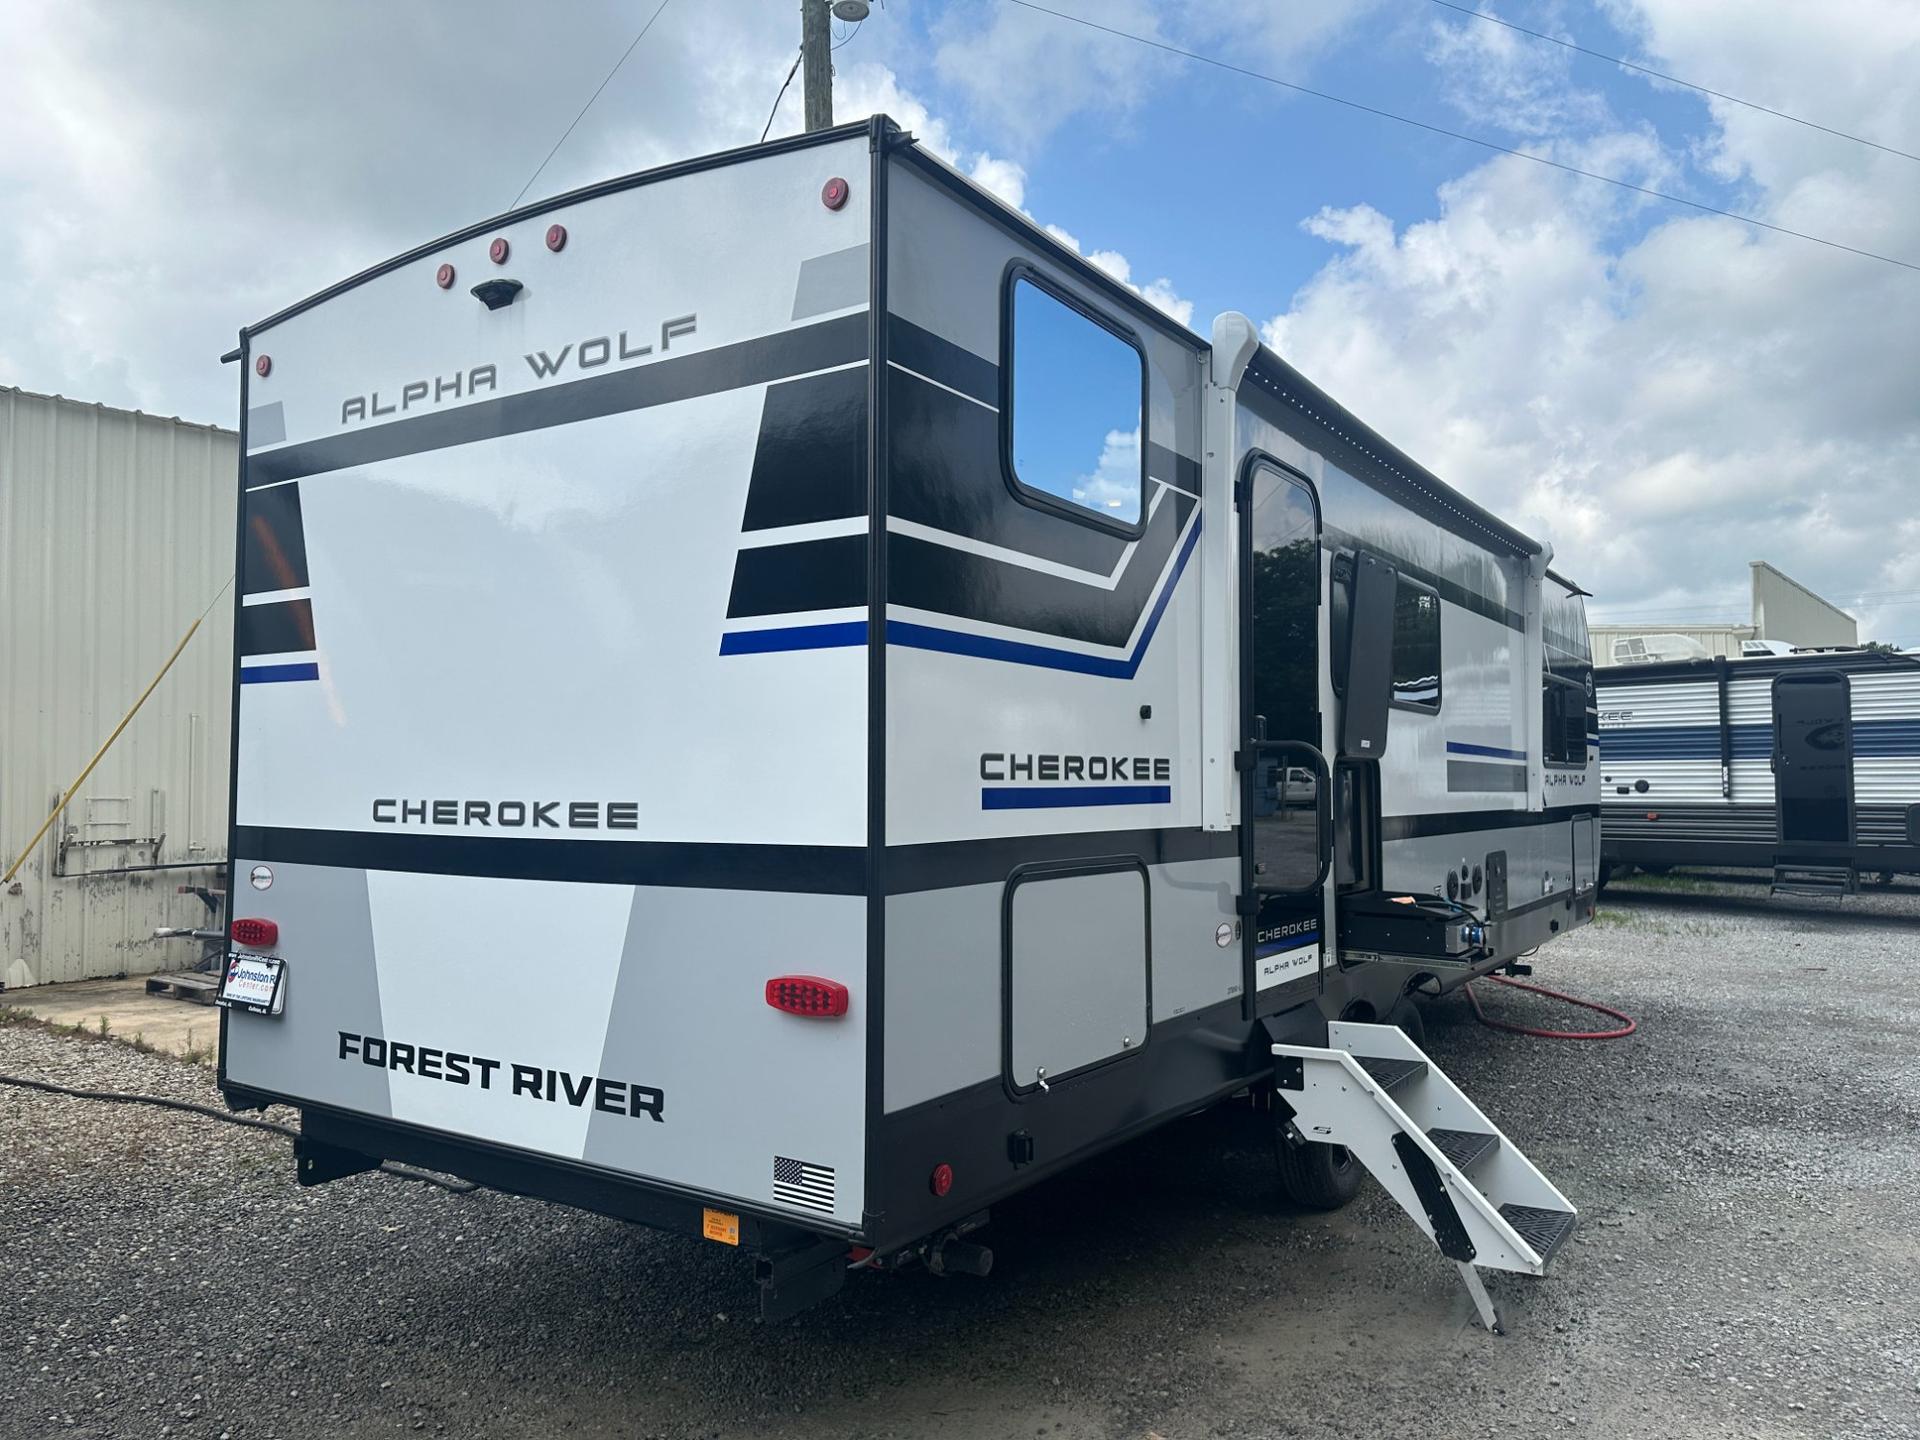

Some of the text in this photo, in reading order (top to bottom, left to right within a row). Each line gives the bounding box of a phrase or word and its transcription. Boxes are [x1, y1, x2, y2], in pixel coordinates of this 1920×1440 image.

[341, 312, 697, 424] ALPHA WOLF
[980, 753, 1171, 781] CHEROKEE
[1545, 774, 1567, 786] ALPHA
[372, 798, 639, 830] CHEROKEE
[1257, 918, 1318, 943] CHEROKEE
[237, 968, 269, 983] Johnston
[1263, 954, 1313, 976] ALPHA WOLF
[338, 1030, 665, 1123] FOREST RIVER
